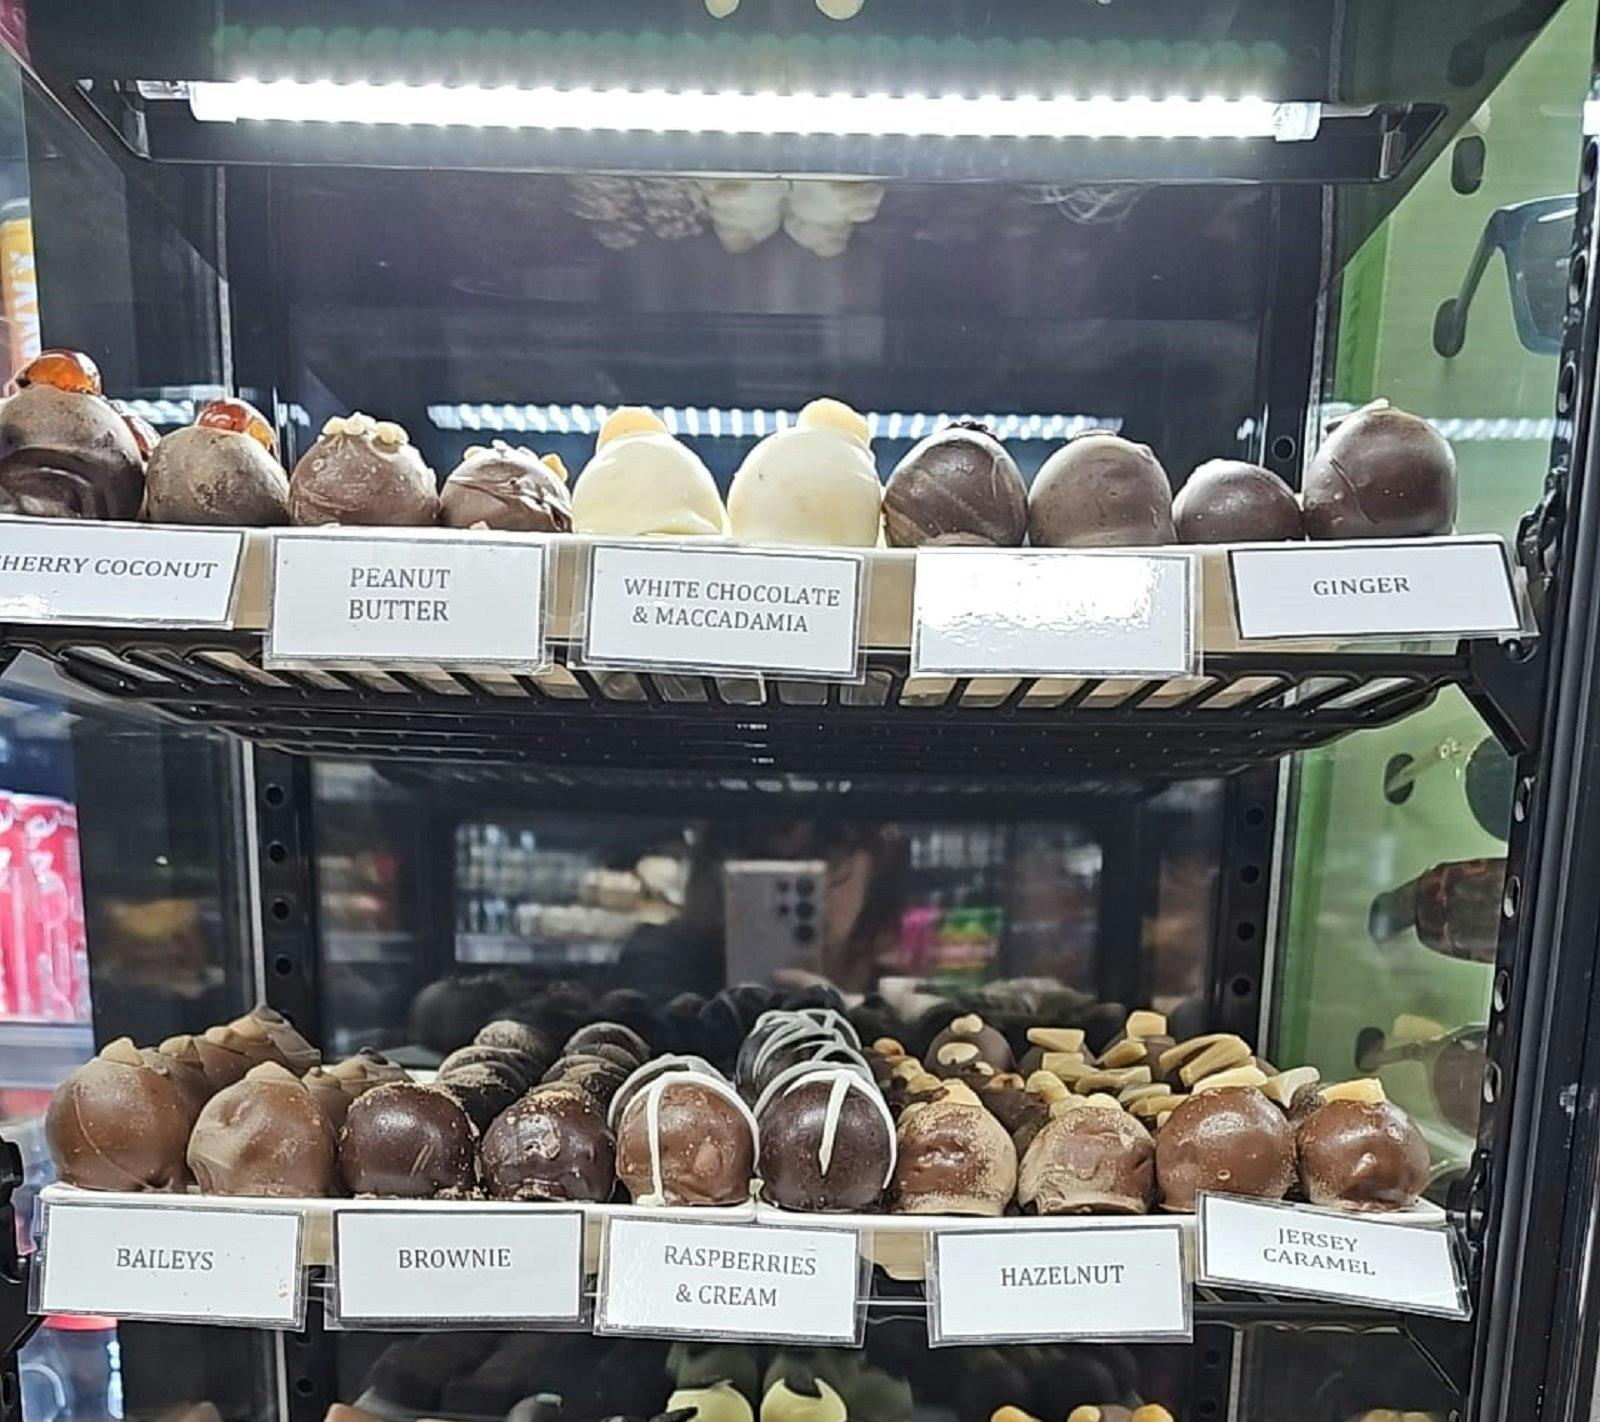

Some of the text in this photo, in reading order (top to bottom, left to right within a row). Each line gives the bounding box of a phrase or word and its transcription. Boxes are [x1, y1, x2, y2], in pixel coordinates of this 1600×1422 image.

[0, 554, 219, 580] HERRY COCONUT
[350, 567, 451, 589] PEANUT
[624, 577, 841, 606] WHITE CHOCOLATE
[1313, 577, 1411, 596] GINGER
[349, 599, 449, 622] BUTTER
[632, 606, 808, 633] & MACCADAMIA
[1277, 1227, 1358, 1253] JERSEY
[116, 1248, 214, 1271] BAILEYS
[398, 1248, 511, 1269] BROWNIE
[664, 1246, 817, 1277] RASPBERRIES
[1263, 1248, 1376, 1276] CARAMEL
[1000, 1264, 1125, 1287] HAZELNUT
[675, 1283, 777, 1307] & CREAM
